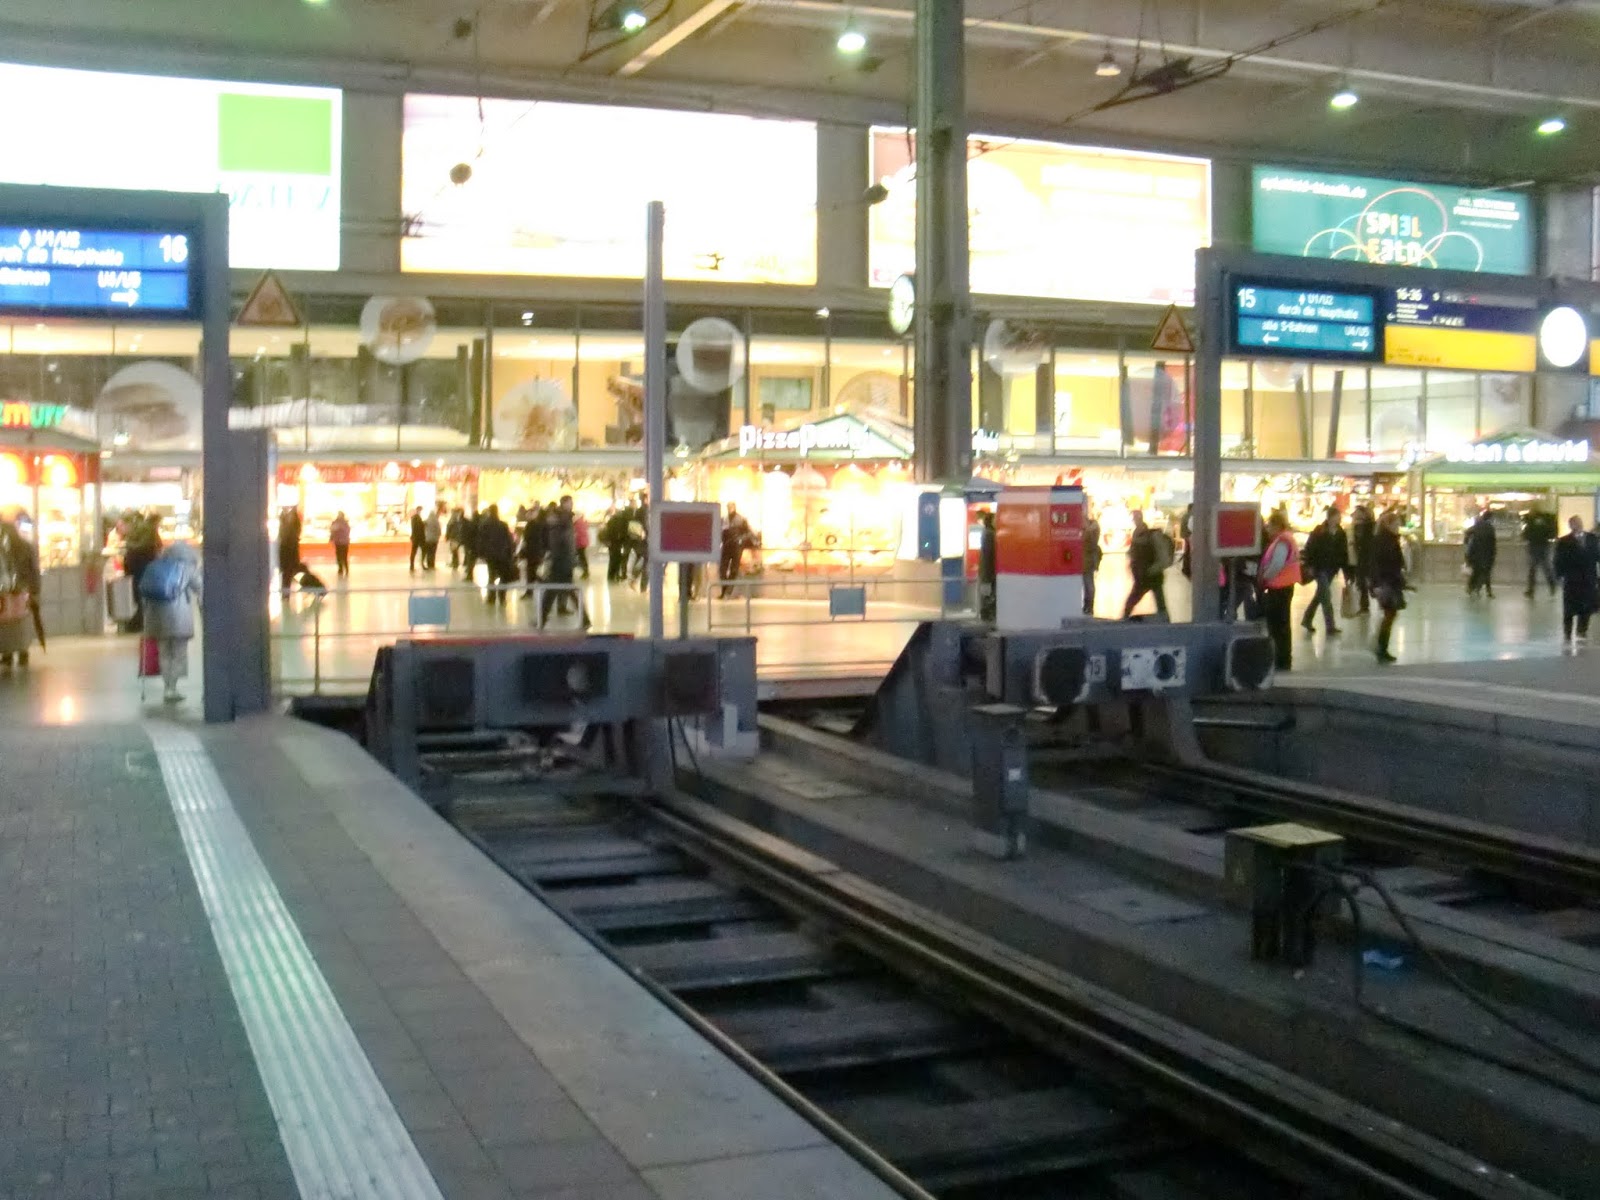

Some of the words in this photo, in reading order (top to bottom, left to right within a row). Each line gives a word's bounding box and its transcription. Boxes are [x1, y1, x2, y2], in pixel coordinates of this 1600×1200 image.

[1366, 212, 1422, 238] SPIEL
[160, 235, 188, 263] 16
[1238, 288, 1256, 308] 15
